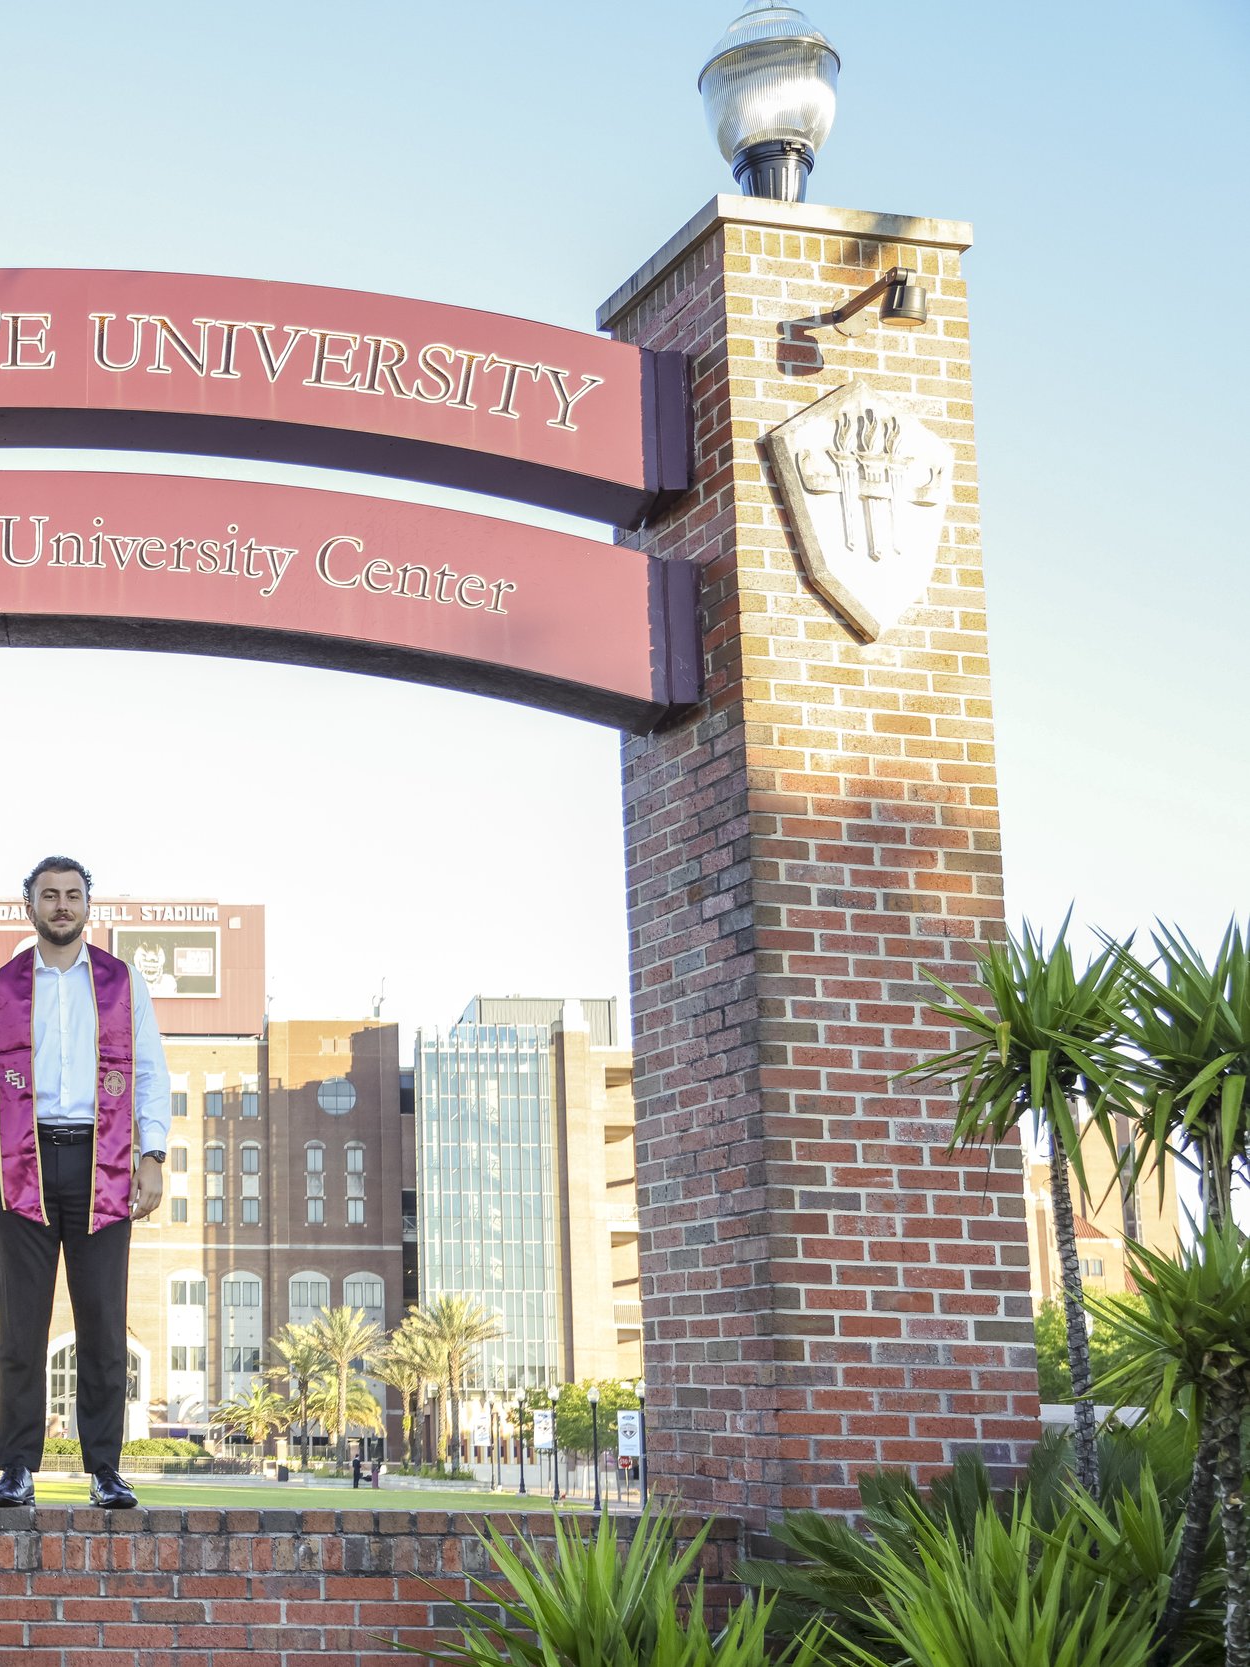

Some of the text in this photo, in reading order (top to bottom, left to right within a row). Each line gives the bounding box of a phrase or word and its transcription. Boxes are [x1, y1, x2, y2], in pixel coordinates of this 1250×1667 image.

[89, 313, 604, 431] UNIVERSITY
[315, 535, 516, 615] Center
[141, 905, 218, 921] STADIUM
[5, 1069, 26, 1089] FSU
